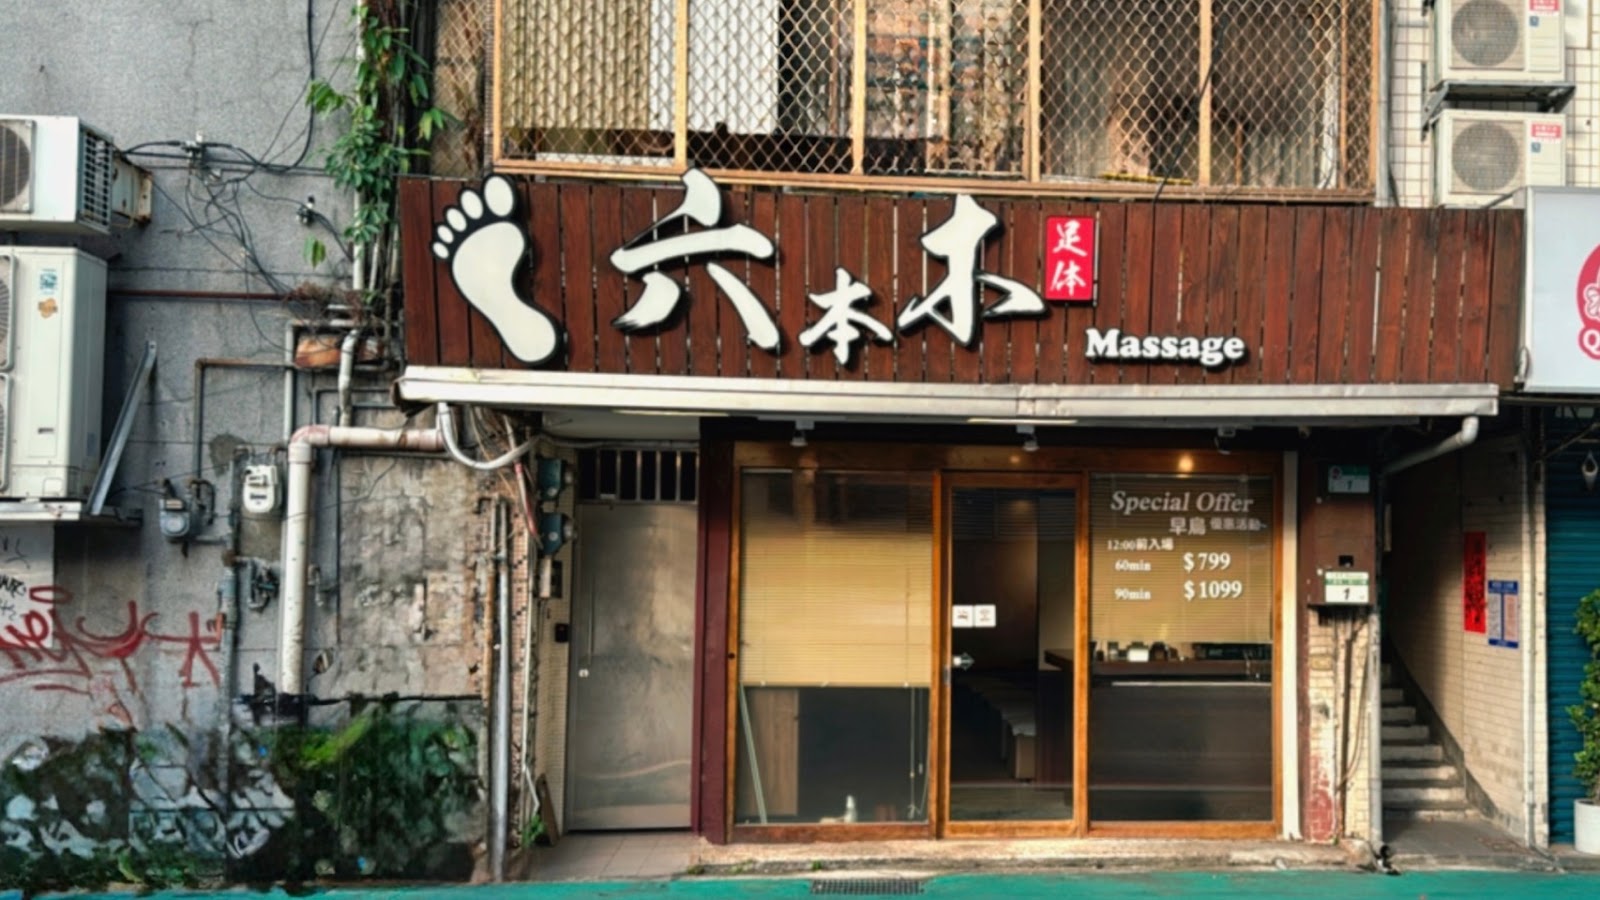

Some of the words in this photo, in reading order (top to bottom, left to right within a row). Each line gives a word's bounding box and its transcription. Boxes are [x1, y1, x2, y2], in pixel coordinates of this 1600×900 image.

[610, 167, 1046, 365] 六本木
[1050, 219, 1088, 296] 足体
[1085, 328, 1245, 366] Massage
[1110, 490, 1190, 516] Special
[1196, 492, 1254, 513] Offer
[1115, 559, 1152, 572] 60min
[1115, 588, 1152, 600] 90min
